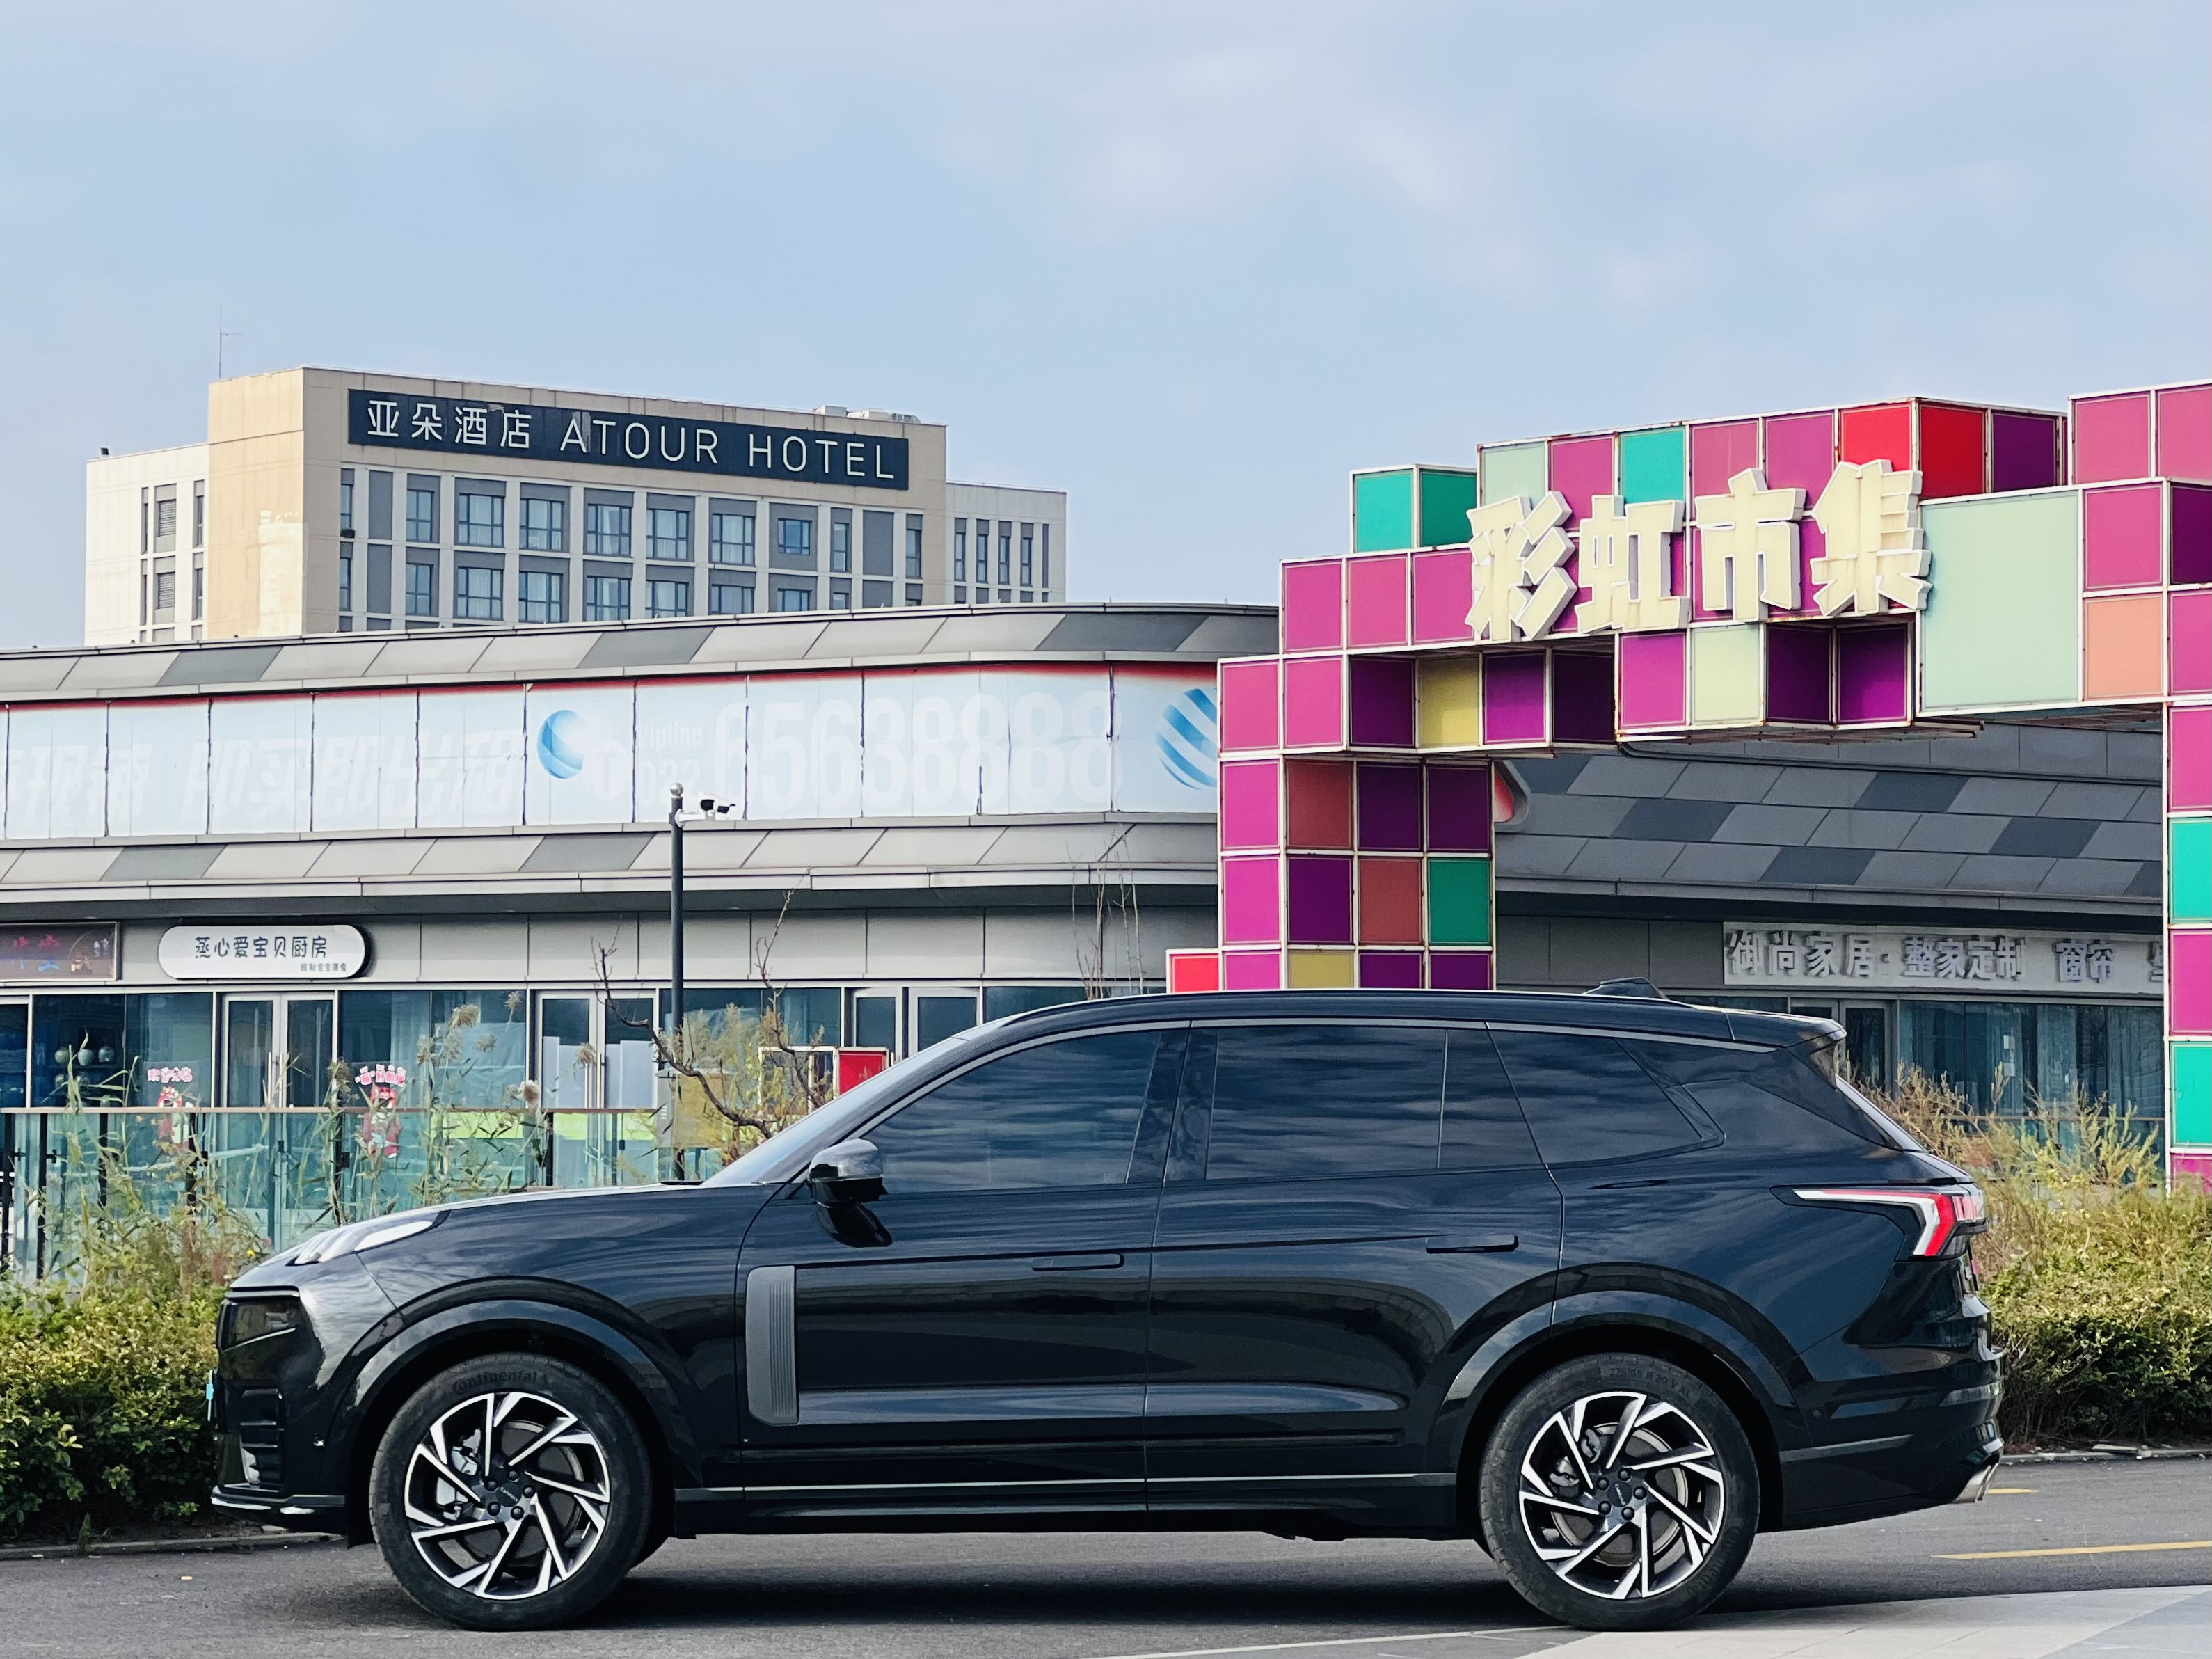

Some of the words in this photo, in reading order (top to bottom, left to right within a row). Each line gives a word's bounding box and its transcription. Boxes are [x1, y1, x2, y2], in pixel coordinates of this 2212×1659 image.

[366, 400, 531, 450] 亚朵酒店
[559, 417, 719, 465] ATOUR
[749, 434, 895, 479] HOTEL
[1465, 459, 1933, 643] 彩虹市集
[715, 690, 1123, 812] 65638888
[2055, 939, 2114, 983] 窗帘
